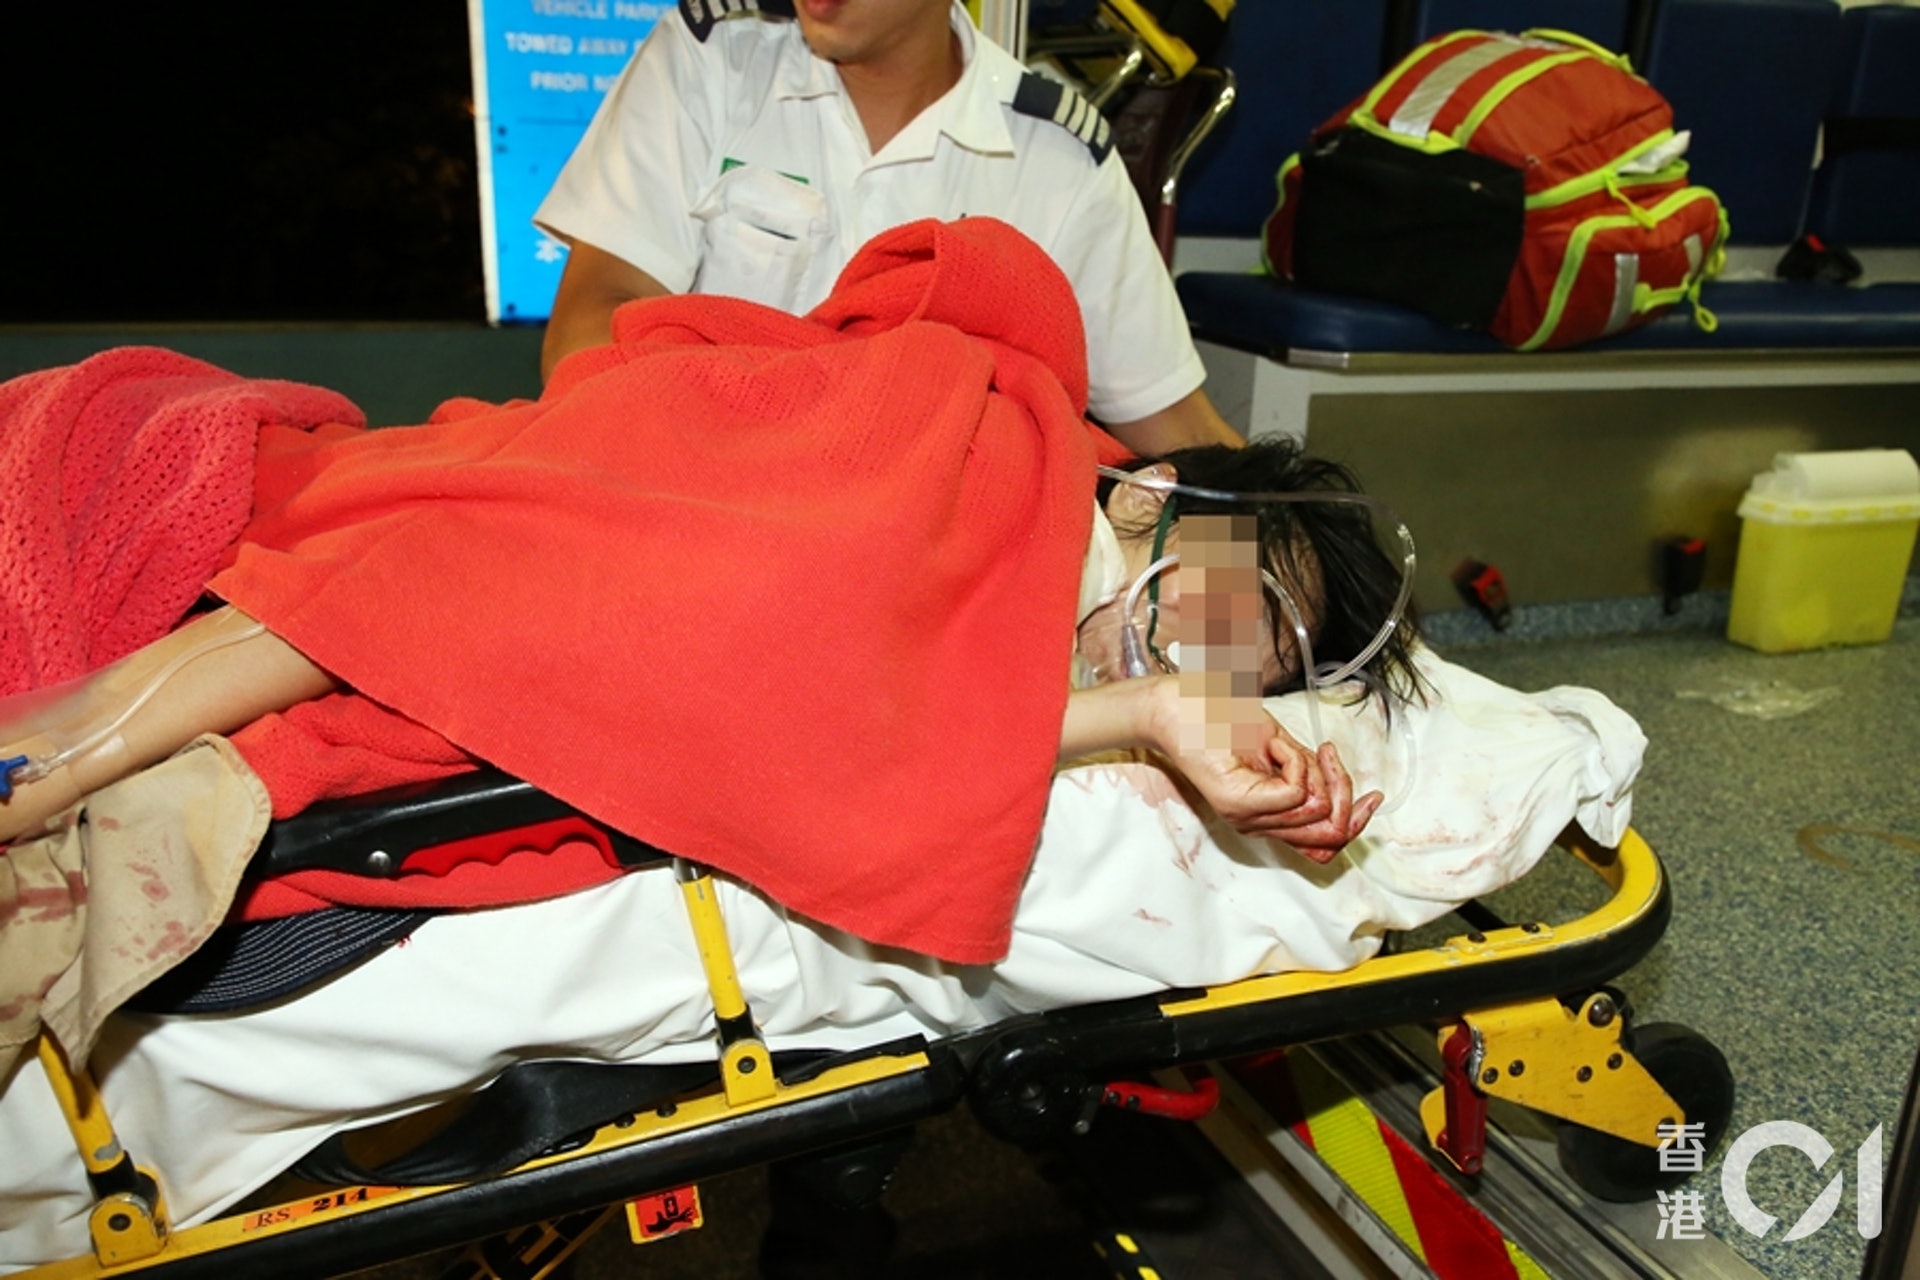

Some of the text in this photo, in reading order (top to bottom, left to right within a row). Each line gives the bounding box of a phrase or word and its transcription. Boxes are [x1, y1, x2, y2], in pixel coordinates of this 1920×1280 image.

[530, 0, 609, 20] VEHICLE
[505, 32, 573, 55] TOWED
[578, 38, 629, 56] AWAY
[530, 71, 590, 93] PRIOR
[256, 1188, 369, 1228] RS 214
